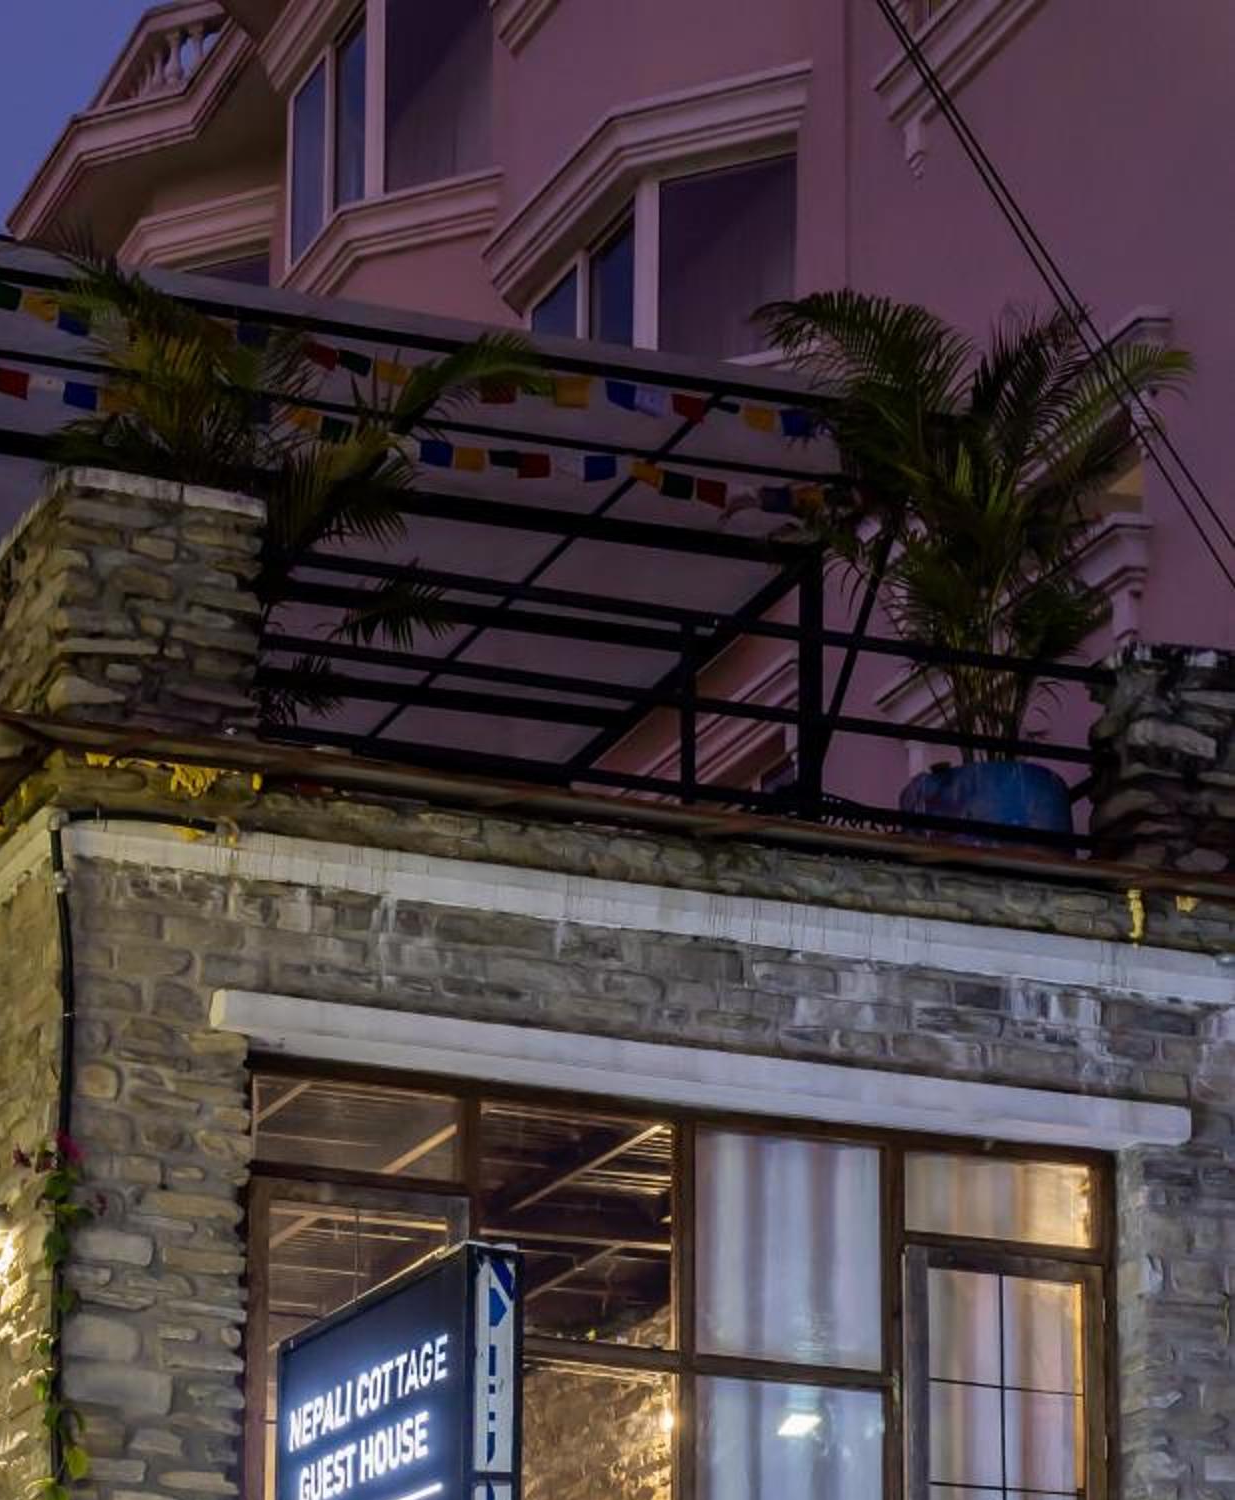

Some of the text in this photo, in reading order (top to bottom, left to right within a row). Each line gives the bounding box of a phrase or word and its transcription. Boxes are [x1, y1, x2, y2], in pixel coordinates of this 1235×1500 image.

[289, 1334, 448, 1452] NEPALI COTTAGE
[359, 1411, 429, 1482] HOUSE
